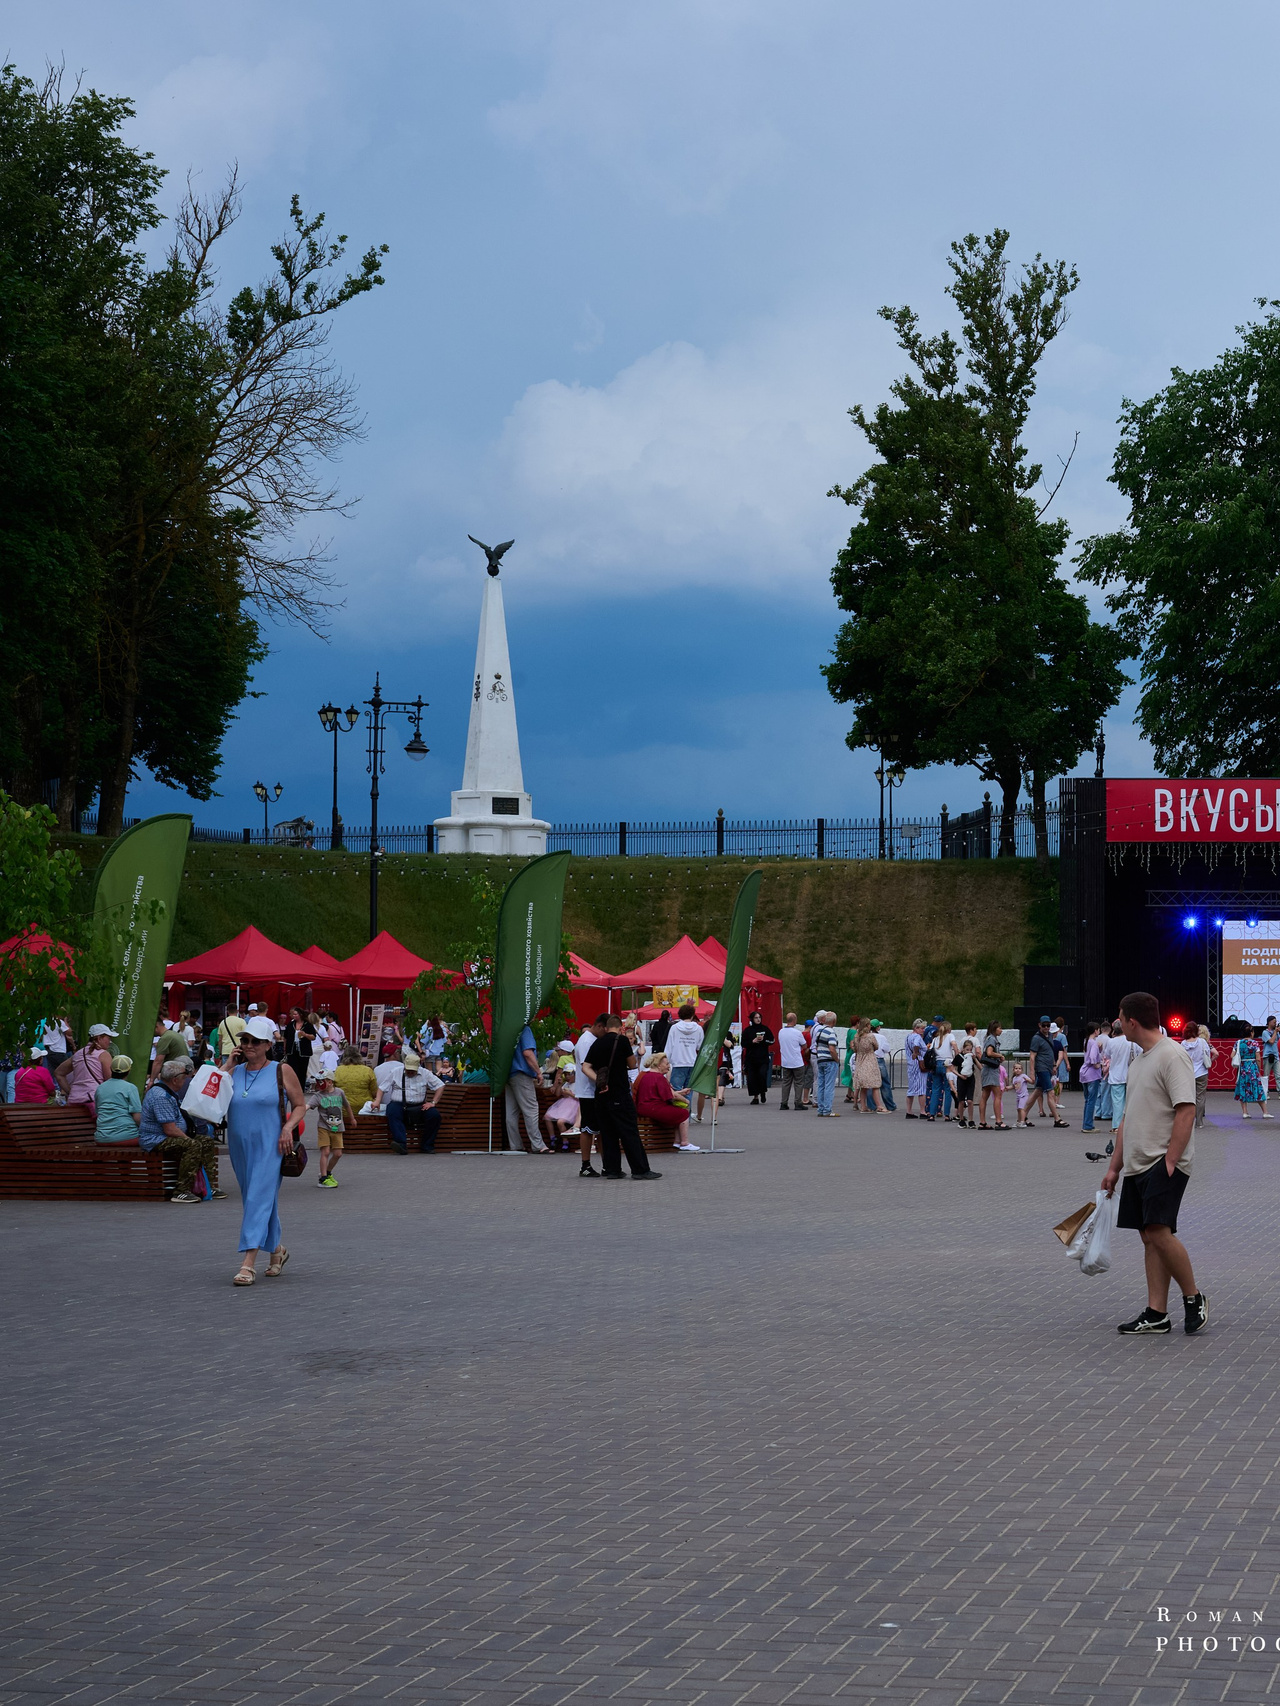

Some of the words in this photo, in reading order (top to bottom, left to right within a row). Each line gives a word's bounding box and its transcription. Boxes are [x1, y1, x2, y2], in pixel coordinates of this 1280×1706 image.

[526, 902, 534, 938] хозяйства
[534, 945, 543, 984] Федерации
[1241, 958, 1259, 966] НА
[523, 976, 533, 1024] Министерство
